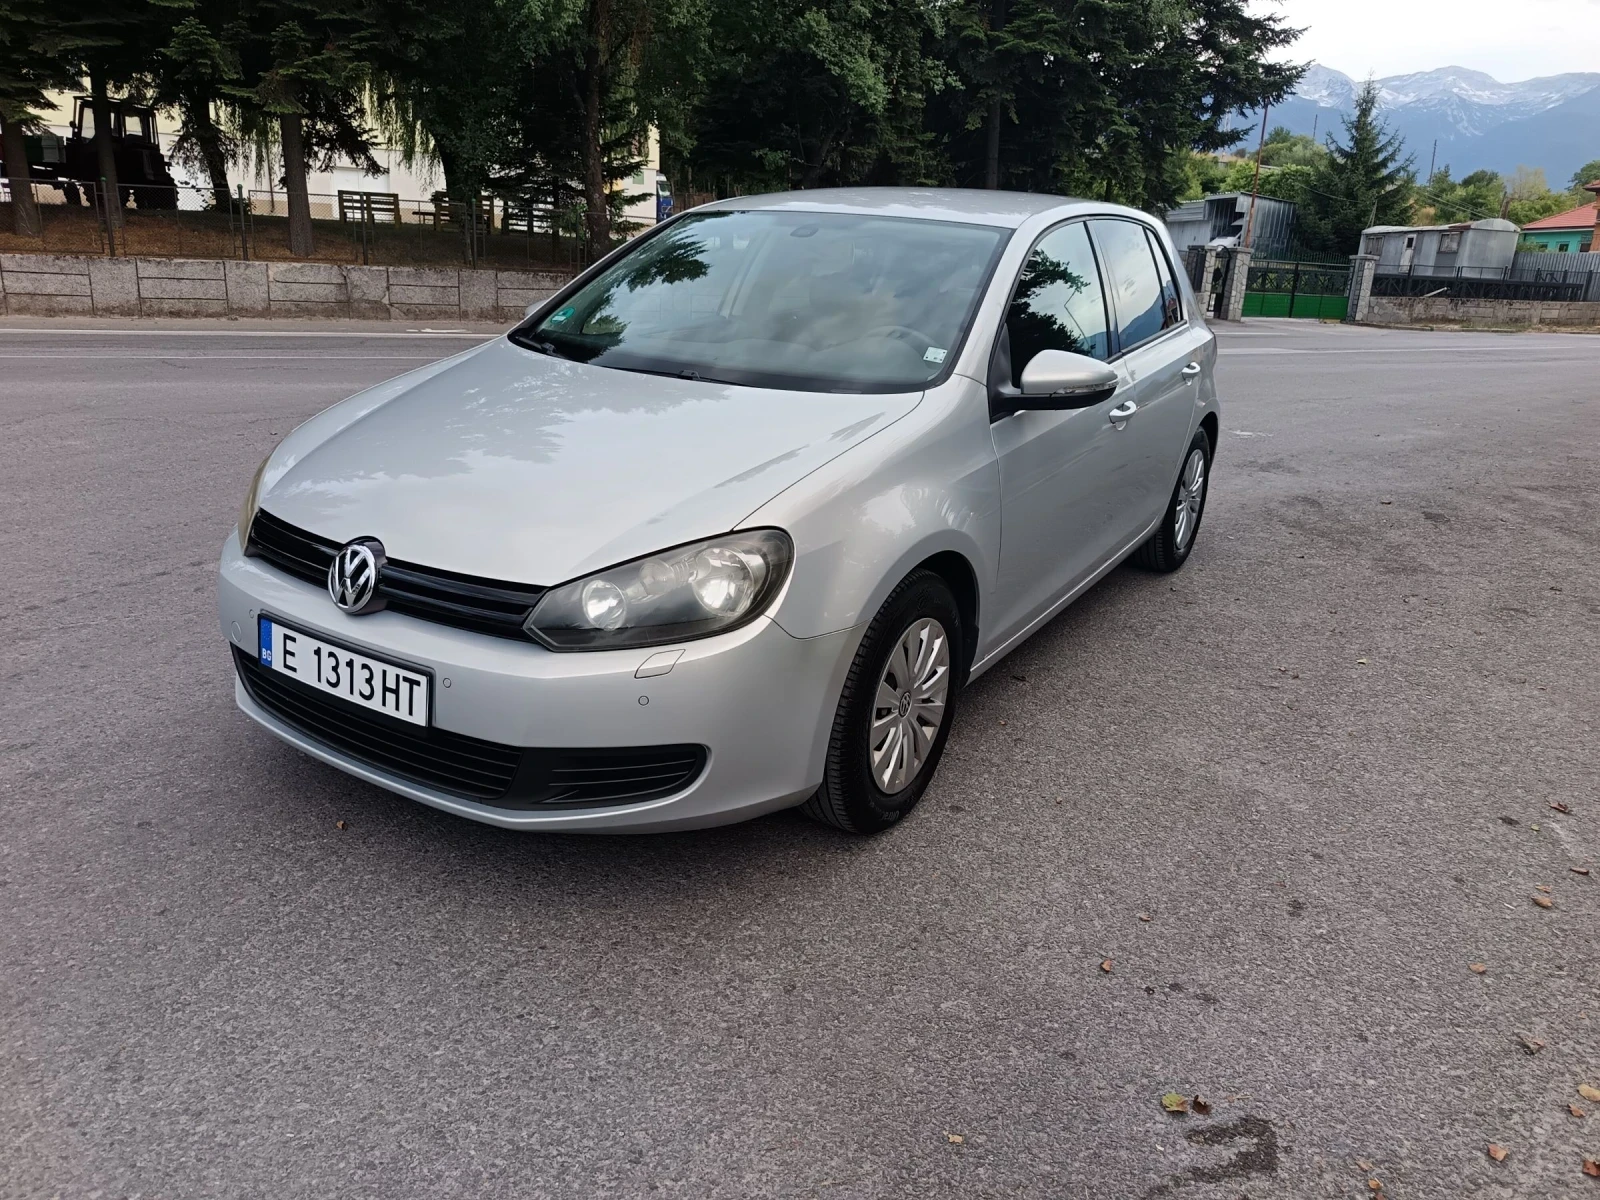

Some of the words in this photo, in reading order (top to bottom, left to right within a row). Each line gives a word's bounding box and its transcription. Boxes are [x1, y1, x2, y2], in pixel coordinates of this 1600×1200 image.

[328, 544, 376, 613] VW
[262, 647, 272, 661] BG
[283, 633, 297, 673] E
